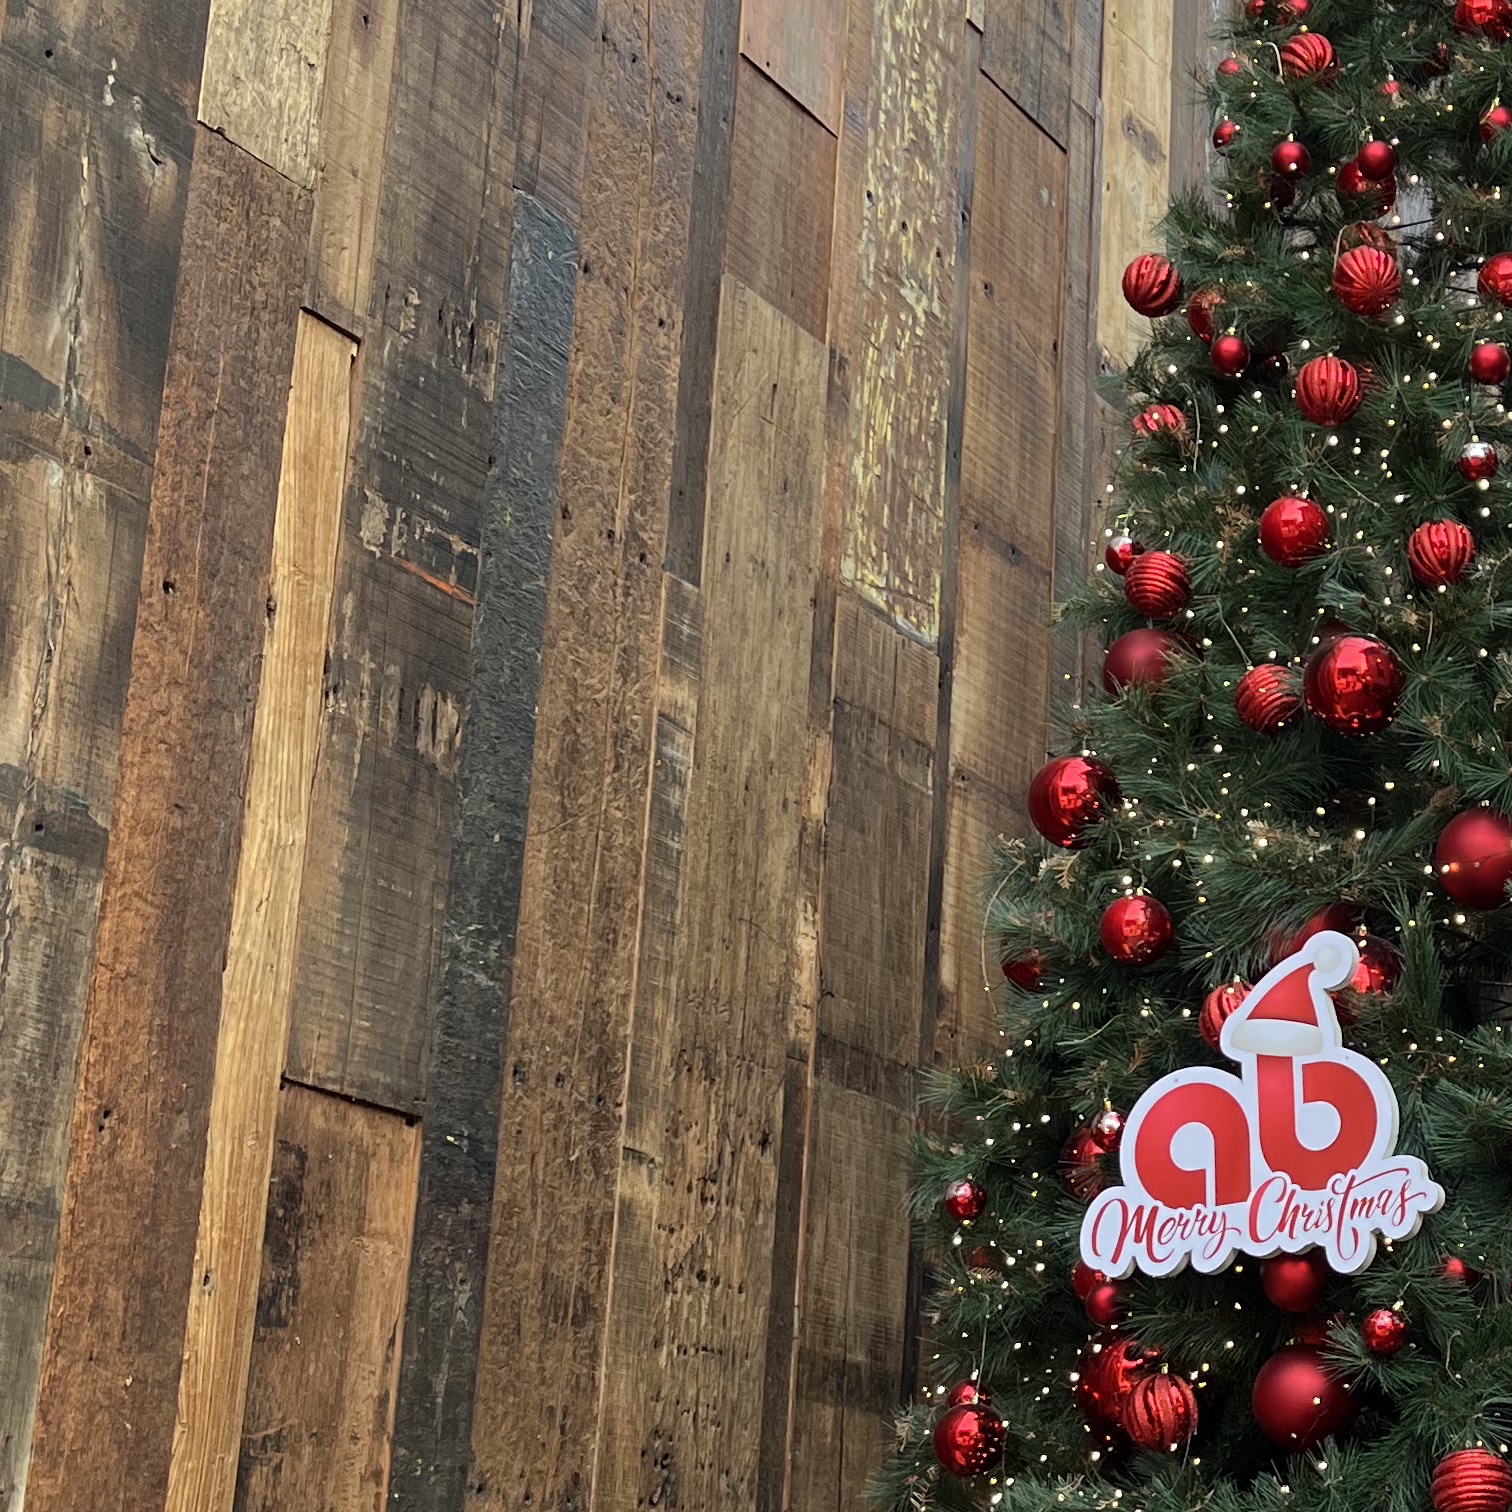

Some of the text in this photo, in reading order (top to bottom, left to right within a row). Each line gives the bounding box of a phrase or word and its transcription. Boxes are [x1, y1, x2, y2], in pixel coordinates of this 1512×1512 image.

[1134, 1053, 1377, 1210] ab
[1091, 1167, 1426, 1264] Merry Christmas
